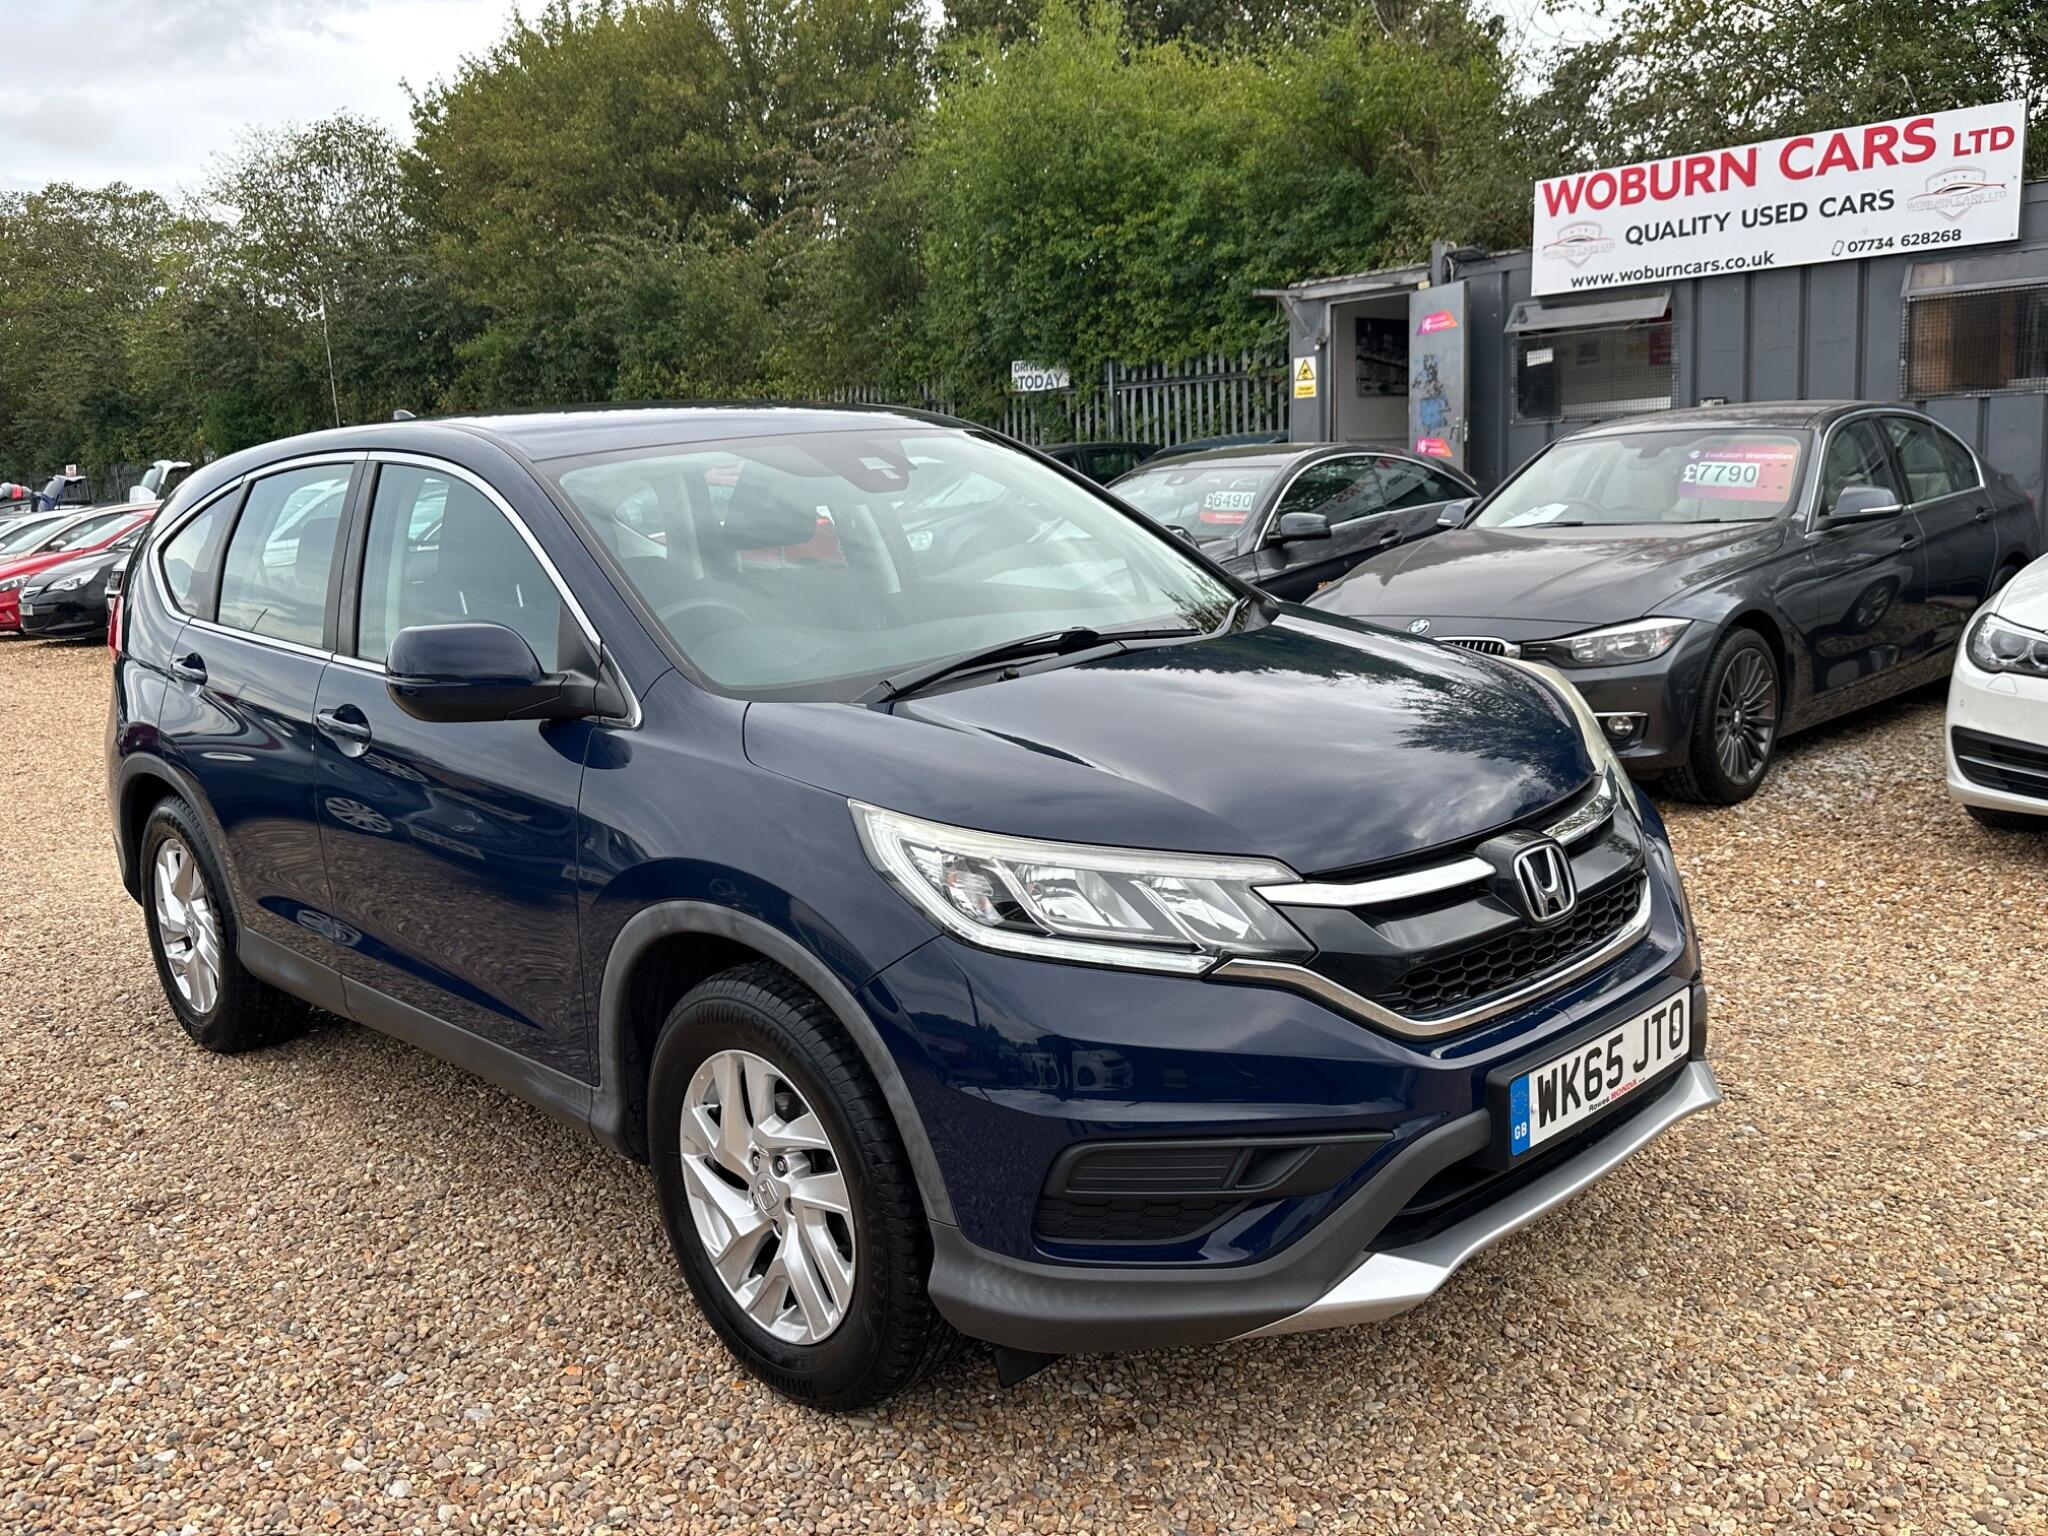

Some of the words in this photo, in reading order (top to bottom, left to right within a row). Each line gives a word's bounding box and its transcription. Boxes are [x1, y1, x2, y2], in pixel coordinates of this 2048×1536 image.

[1542, 146, 1758, 218] WOBURN
[1779, 117, 1938, 181] CARS
[1953, 125, 2015, 158] LTD
[1625, 212, 1732, 246] QUALITY
[1741, 200, 1808, 230] USED
[1819, 189, 1896, 219] CARS
[1847, 236, 1895, 254] 07734
[1900, 227, 1963, 248] 628268
[1569, 250, 1776, 290] www.woburncars.co.uk
[1018, 372, 1063, 390] TODAY
[1681, 463, 1758, 484] £7790
[1203, 492, 1253, 508] £6490
[1537, 1032, 1624, 1130] WK65
[1632, 998, 1684, 1074] JTO
[1610, 1079, 1638, 1102] HONDA
[1514, 1120, 1528, 1141] GB
